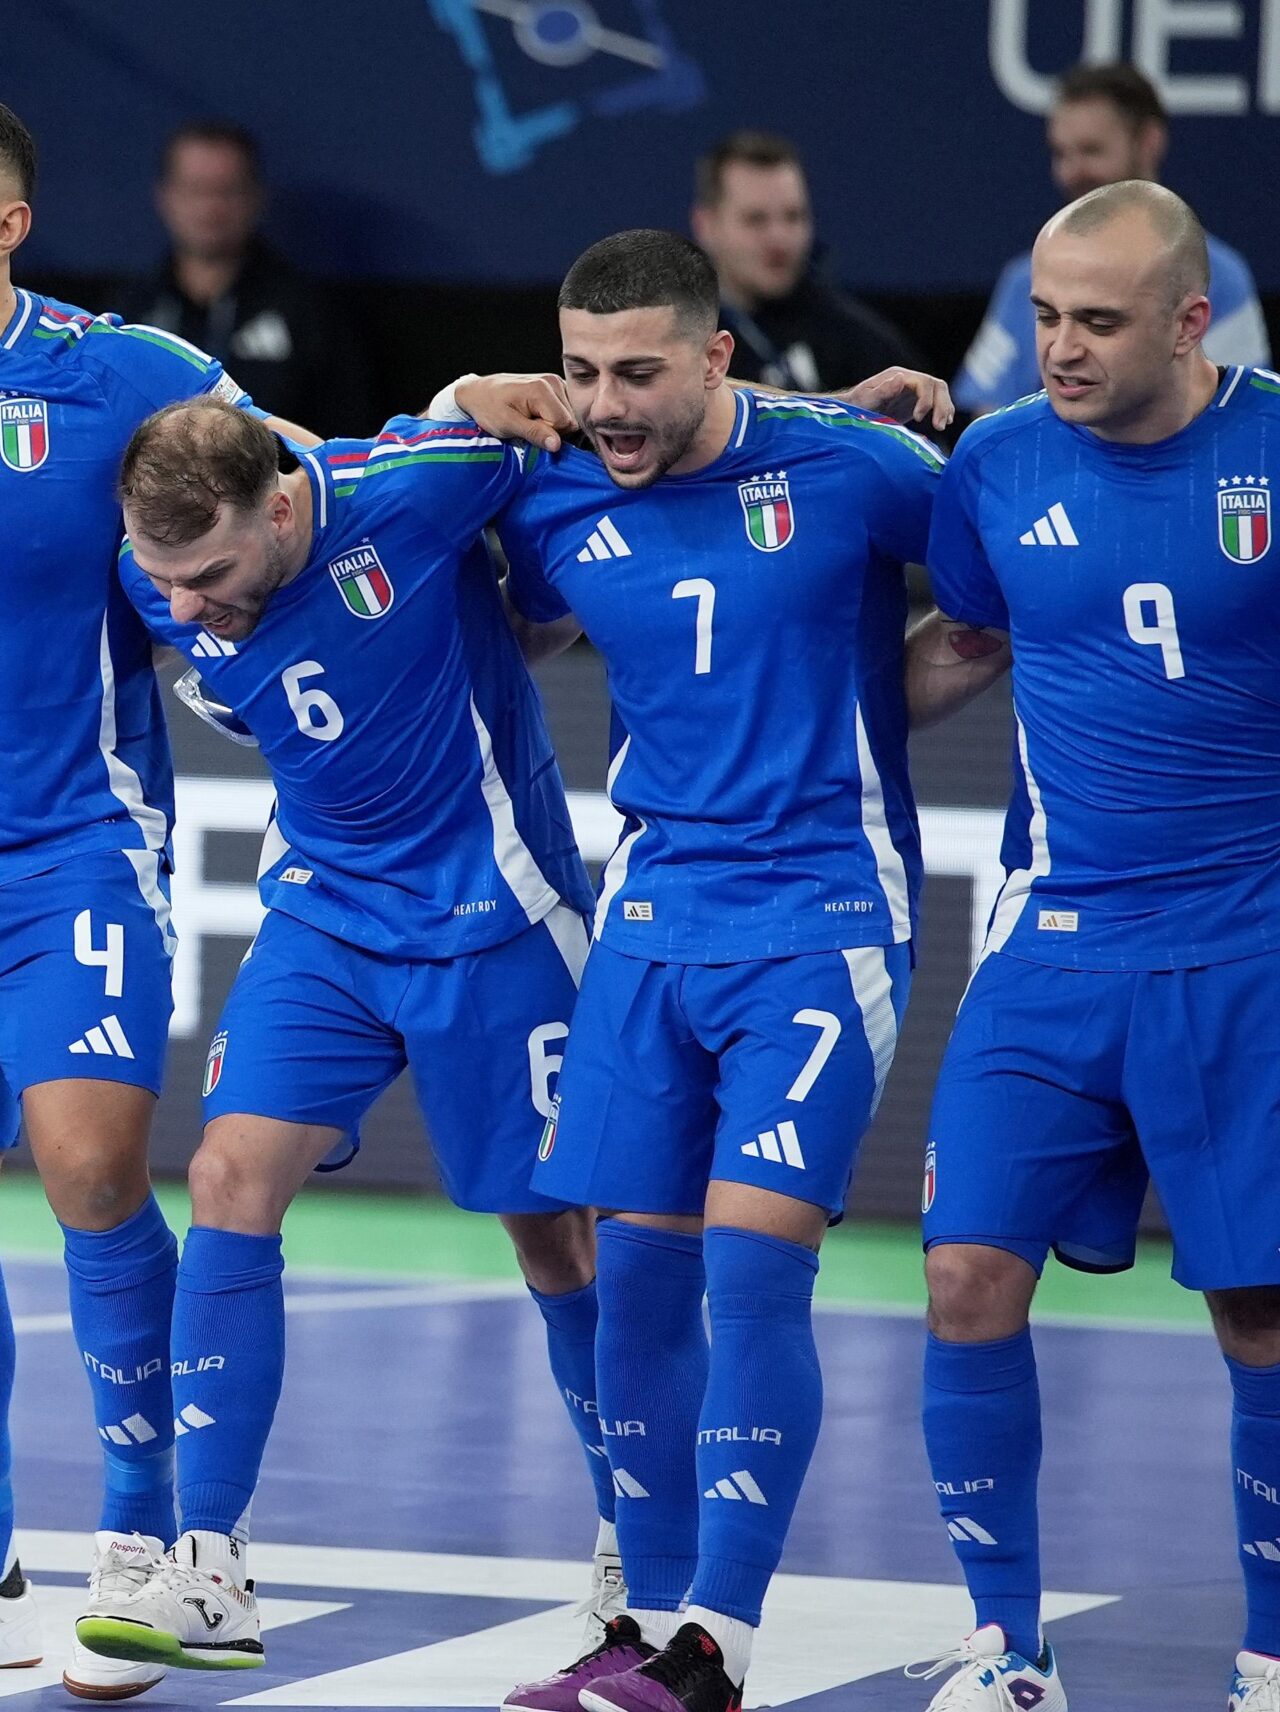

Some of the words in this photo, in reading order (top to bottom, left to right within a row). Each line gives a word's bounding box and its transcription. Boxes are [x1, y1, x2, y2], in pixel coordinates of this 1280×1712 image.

[2, 404, 43, 420] ITALIA
[743, 484, 785, 503] ITALIA
[1222, 495, 1266, 510] ITALIA
[333, 551, 375, 577] ITALIA
[672, 579, 715, 674] 7
[1123, 583, 1184, 679] 9
[282, 661, 343, 740] 6
[454, 900, 496, 916] HEAT.RDY
[825, 902, 874, 912] HEAT.RDY
[74, 909, 123, 997] 4
[786, 1009, 841, 1102] 7
[528, 1022, 569, 1118] 6
[83, 1351, 161, 1384] ITALIA
[170, 1355, 224, 1378] ALIA
[697, 1427, 781, 1445] ITALIA
[932, 1478, 994, 1495] ALIA
